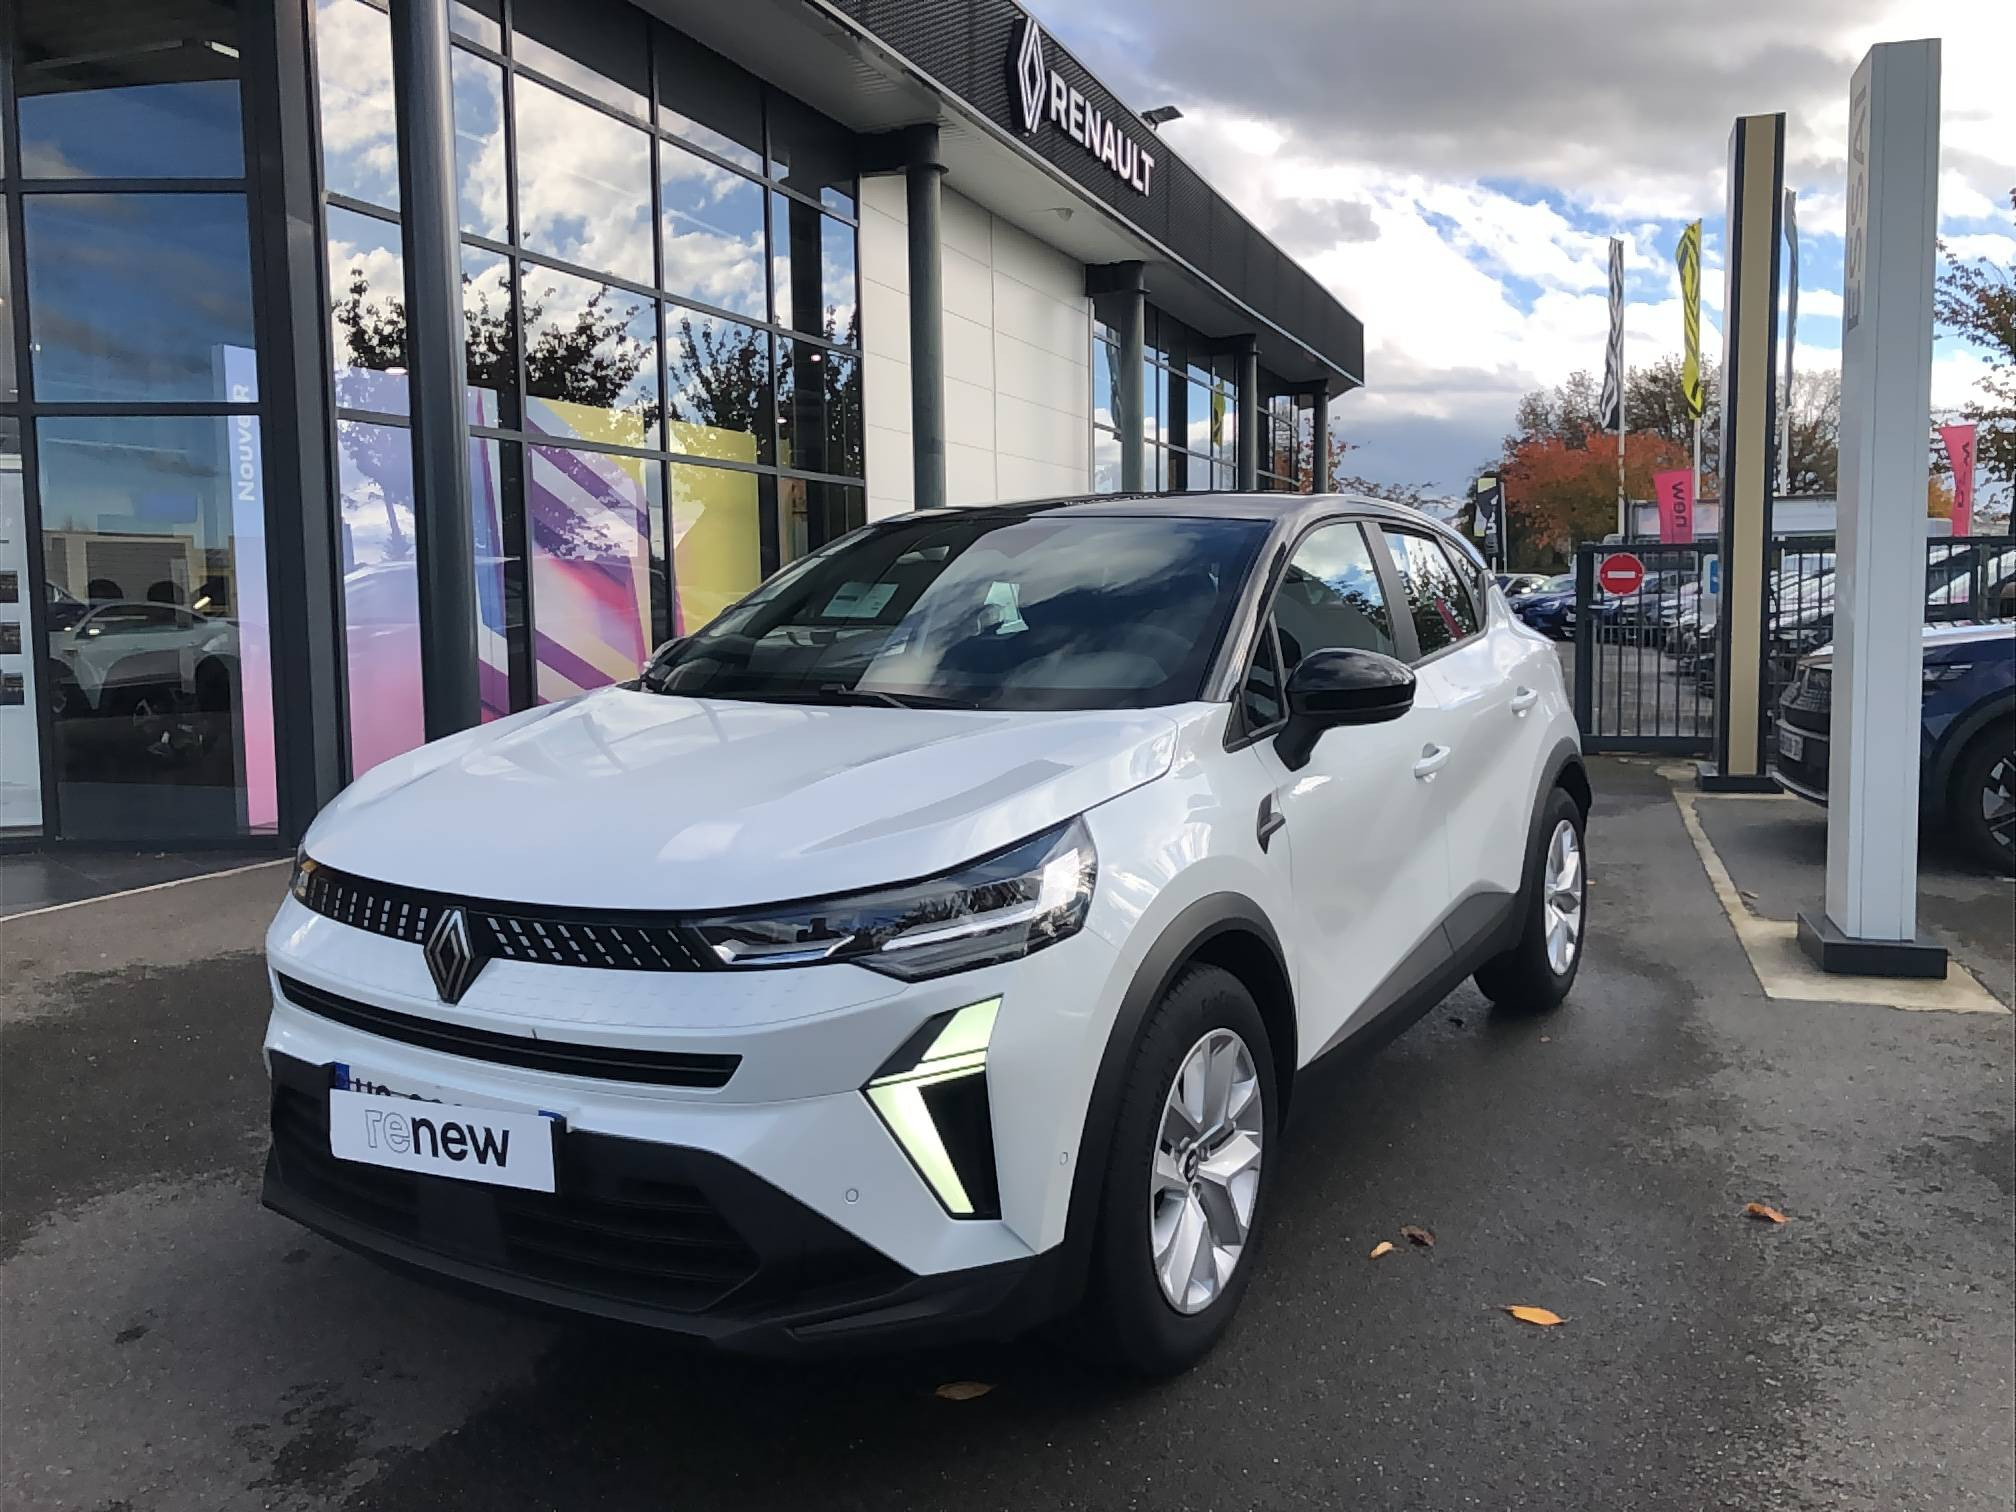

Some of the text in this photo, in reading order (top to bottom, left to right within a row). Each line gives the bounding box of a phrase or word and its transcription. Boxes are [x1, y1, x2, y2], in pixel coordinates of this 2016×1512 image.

[1051, 69, 1154, 197] RENAULT
[1847, 85, 1867, 333] ESSAI
[364, 1109, 510, 1168] renew
